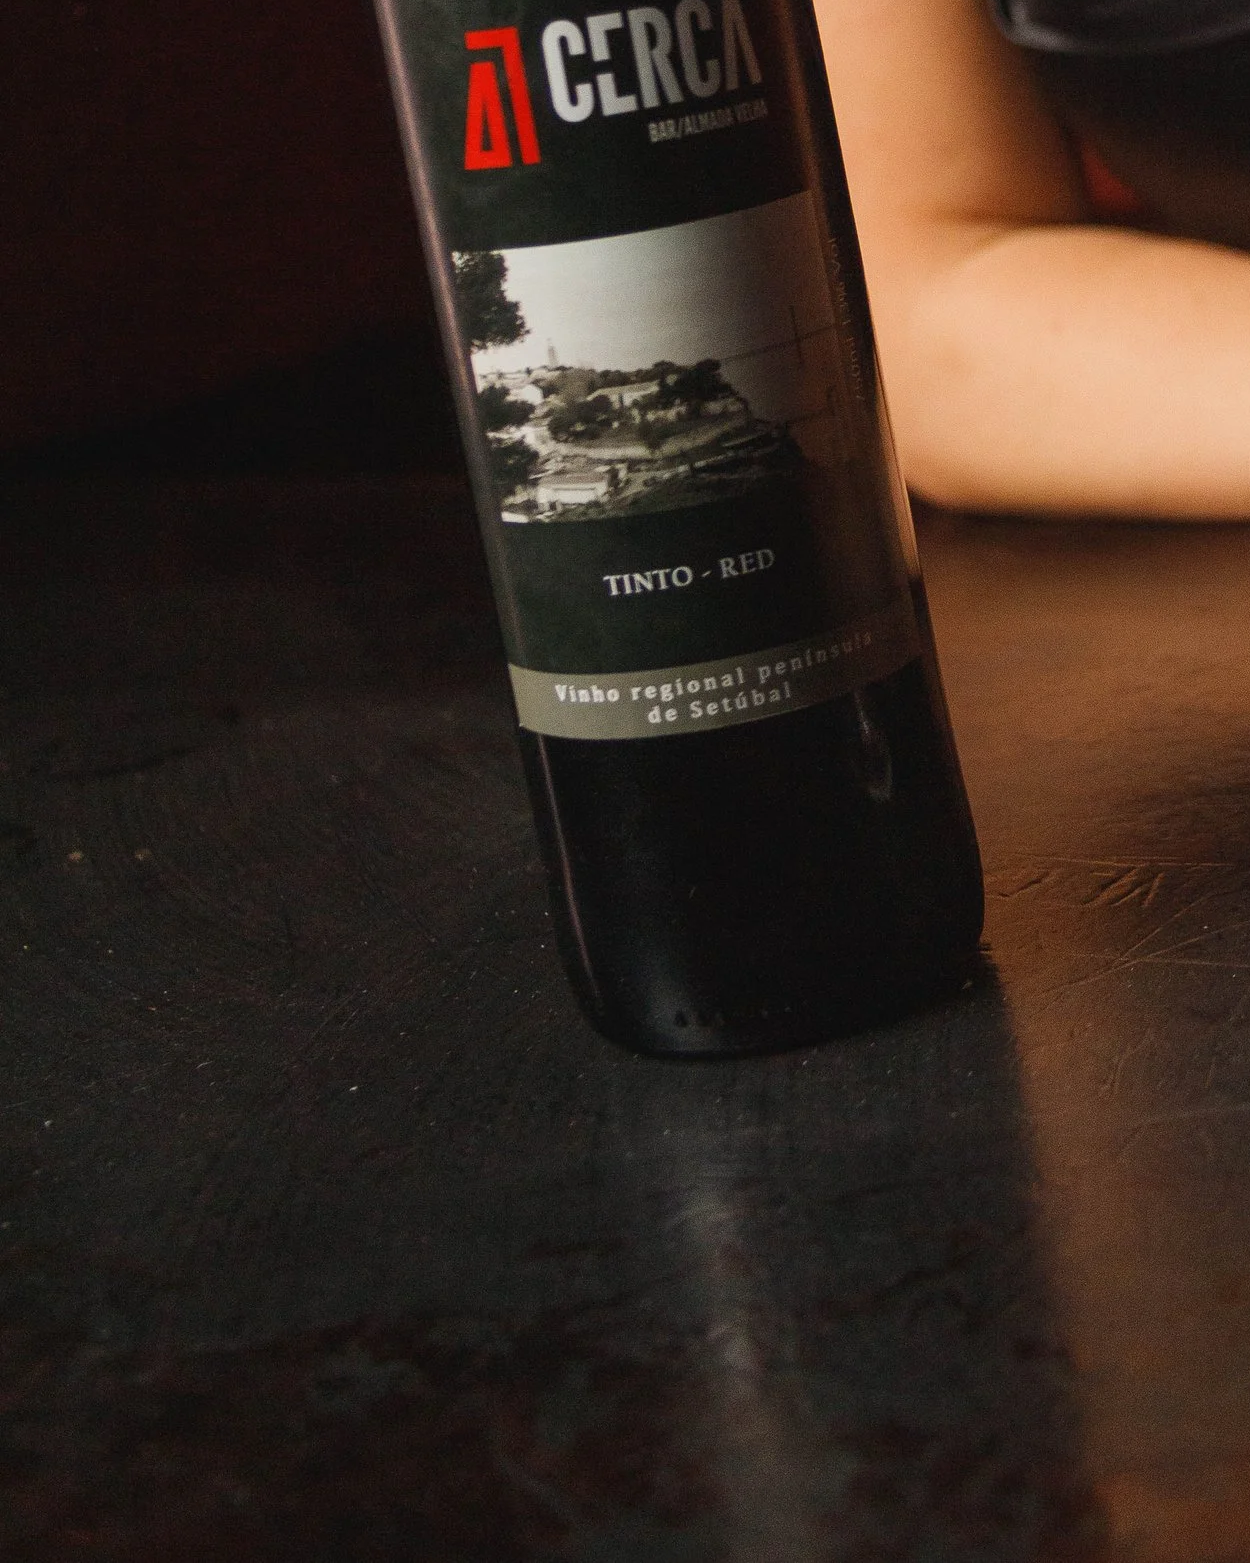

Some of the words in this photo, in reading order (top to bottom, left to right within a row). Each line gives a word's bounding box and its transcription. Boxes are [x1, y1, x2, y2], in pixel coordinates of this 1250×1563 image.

[603, 564, 694, 598] TINTO
[718, 547, 777, 581] RED
[554, 683, 621, 703] Vinho
[630, 666, 745, 703] regional
[647, 704, 679, 725] de
[689, 680, 792, 719] Setúbal
